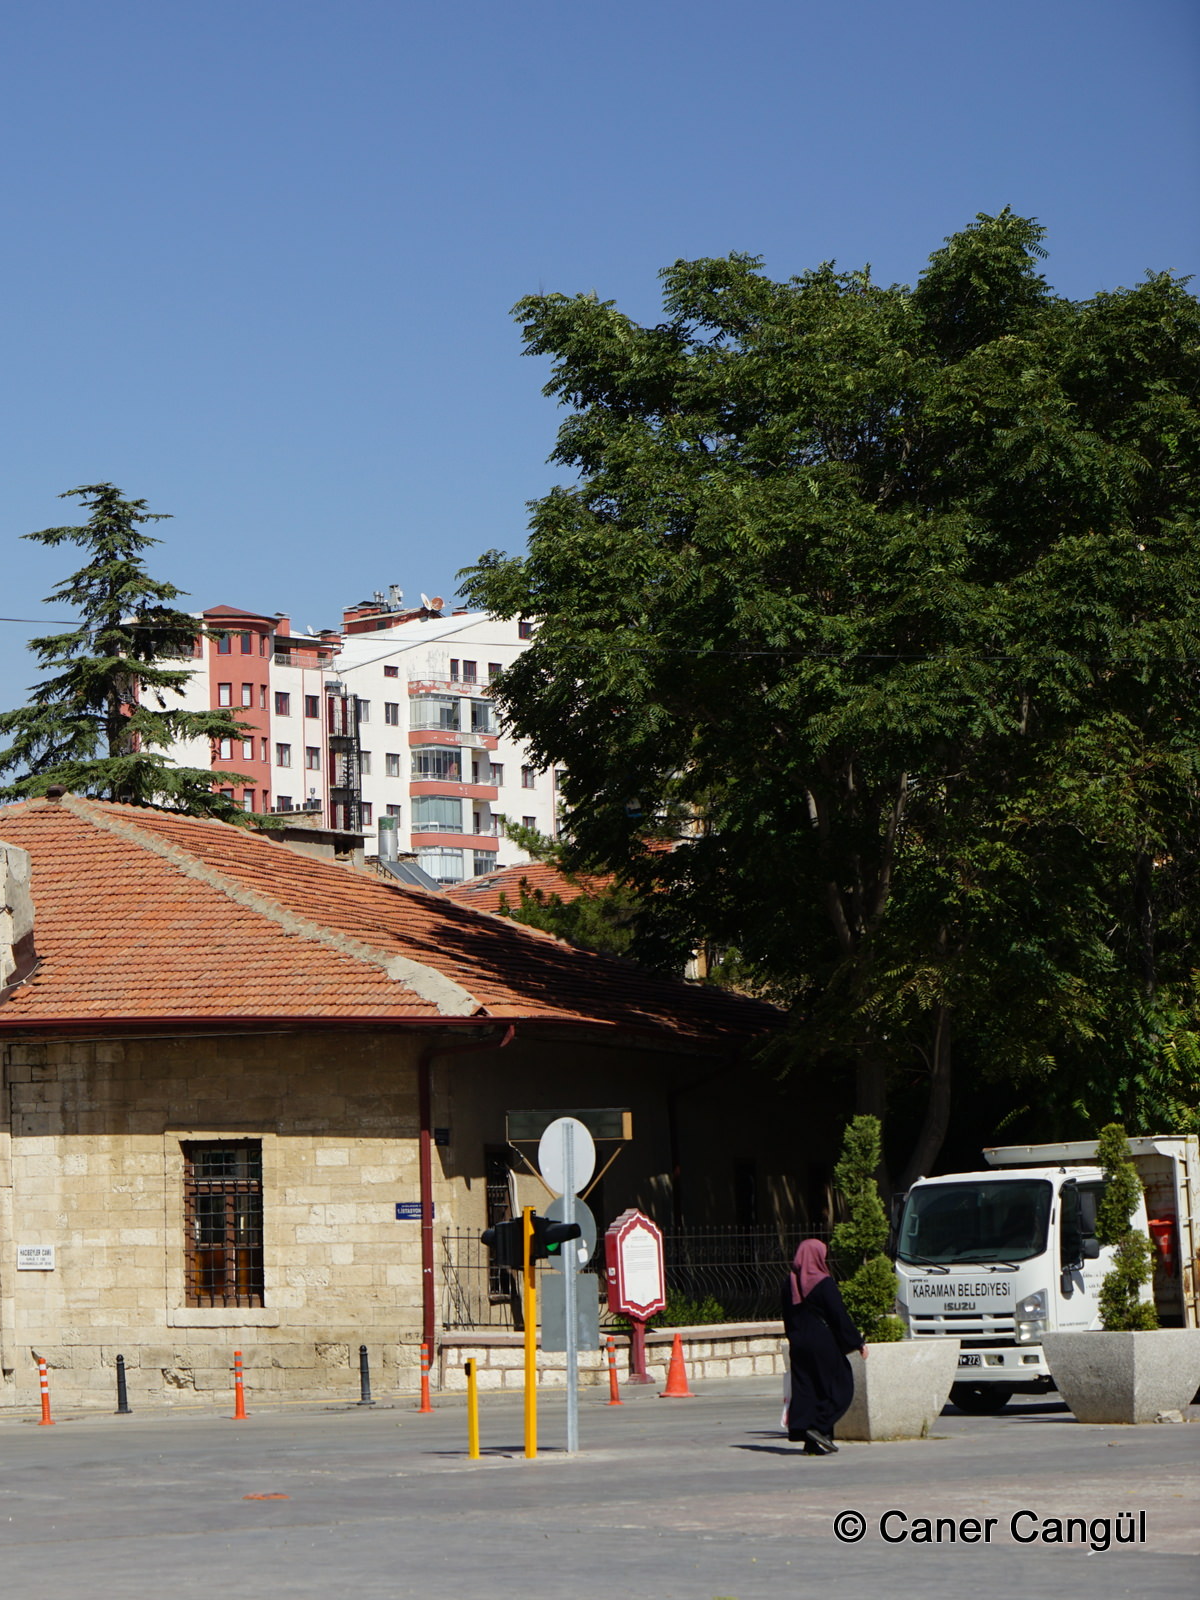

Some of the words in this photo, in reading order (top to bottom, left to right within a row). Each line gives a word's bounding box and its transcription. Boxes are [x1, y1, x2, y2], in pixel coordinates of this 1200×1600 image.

[913, 1284, 955, 1298] KARAMAN
[944, 1302, 976, 1311] ISUZU
[967, 1355, 981, 1365] 273
